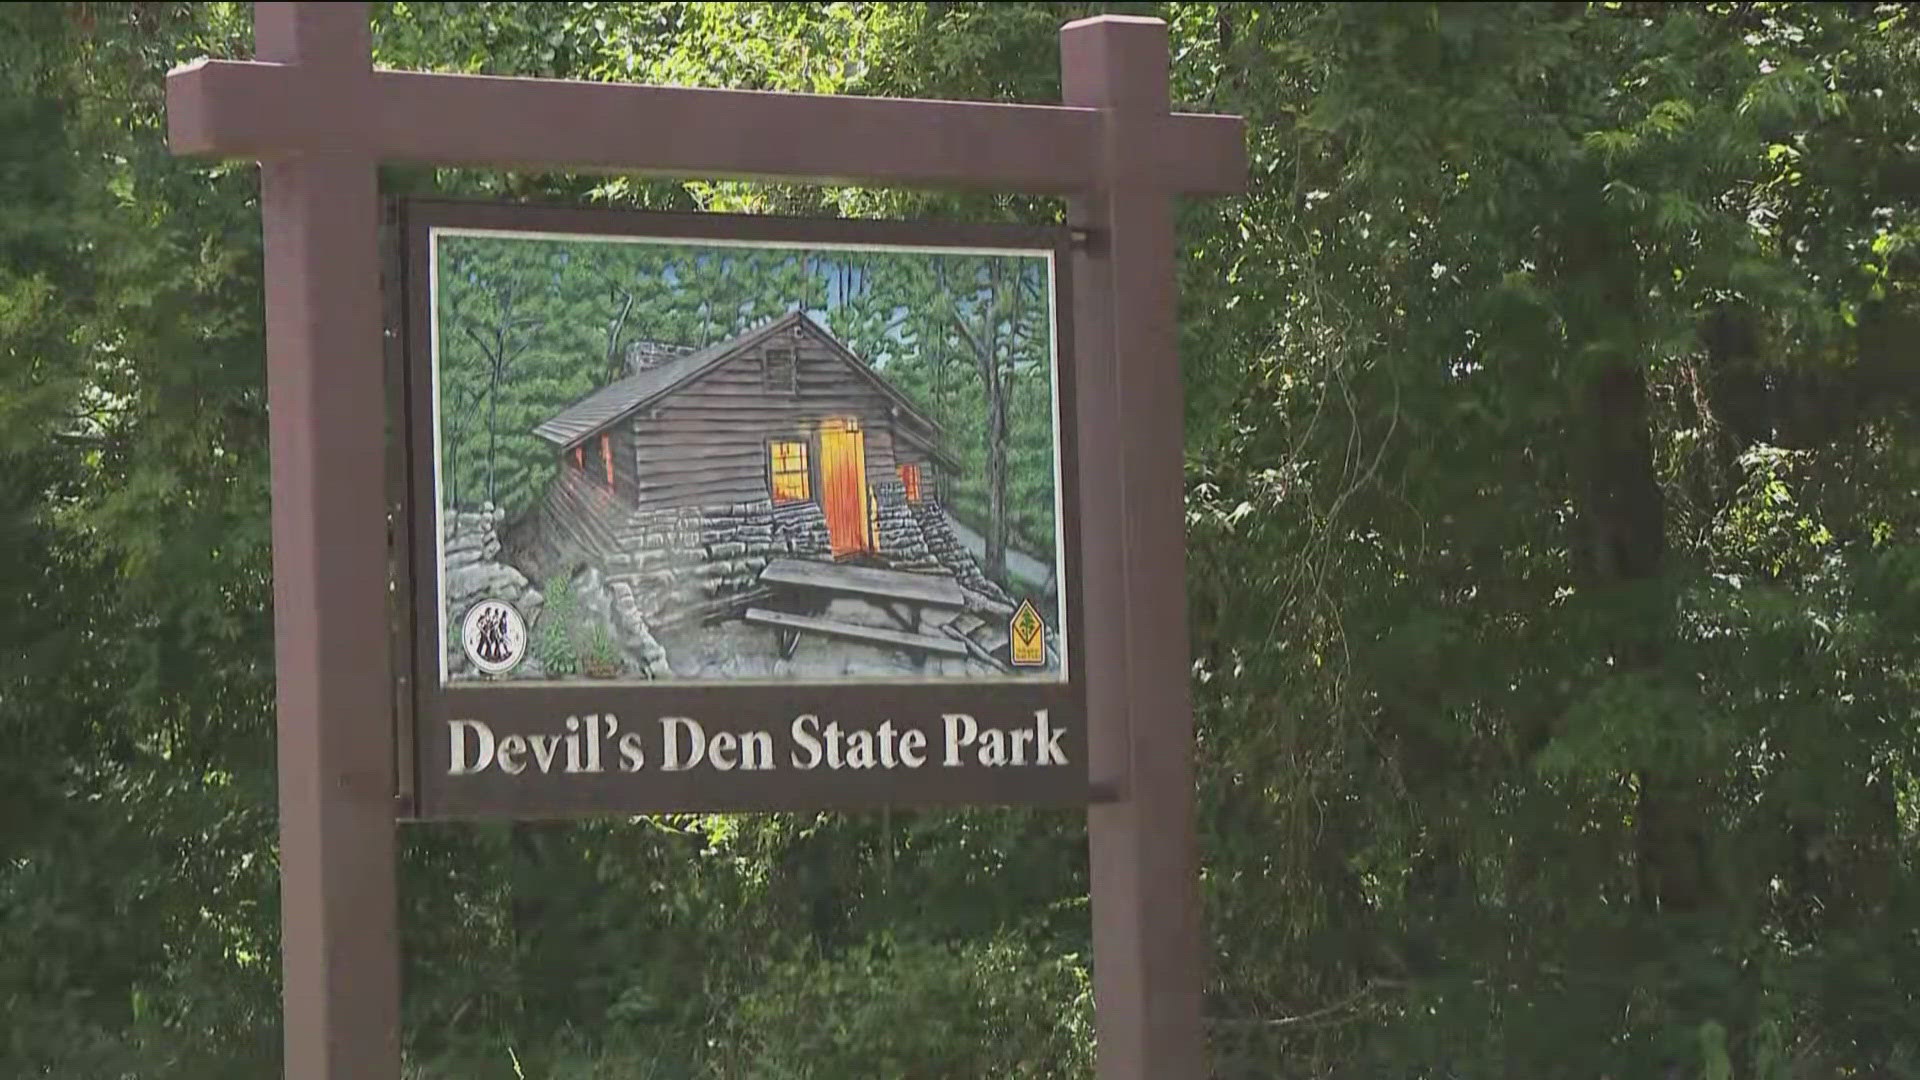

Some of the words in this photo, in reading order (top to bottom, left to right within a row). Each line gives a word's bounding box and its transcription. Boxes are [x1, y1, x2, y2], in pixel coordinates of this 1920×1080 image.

[448, 713, 645, 775] Devil's
[659, 717, 776, 772] Den
[791, 714, 927, 770] State
[942, 709, 1068, 767] Park
